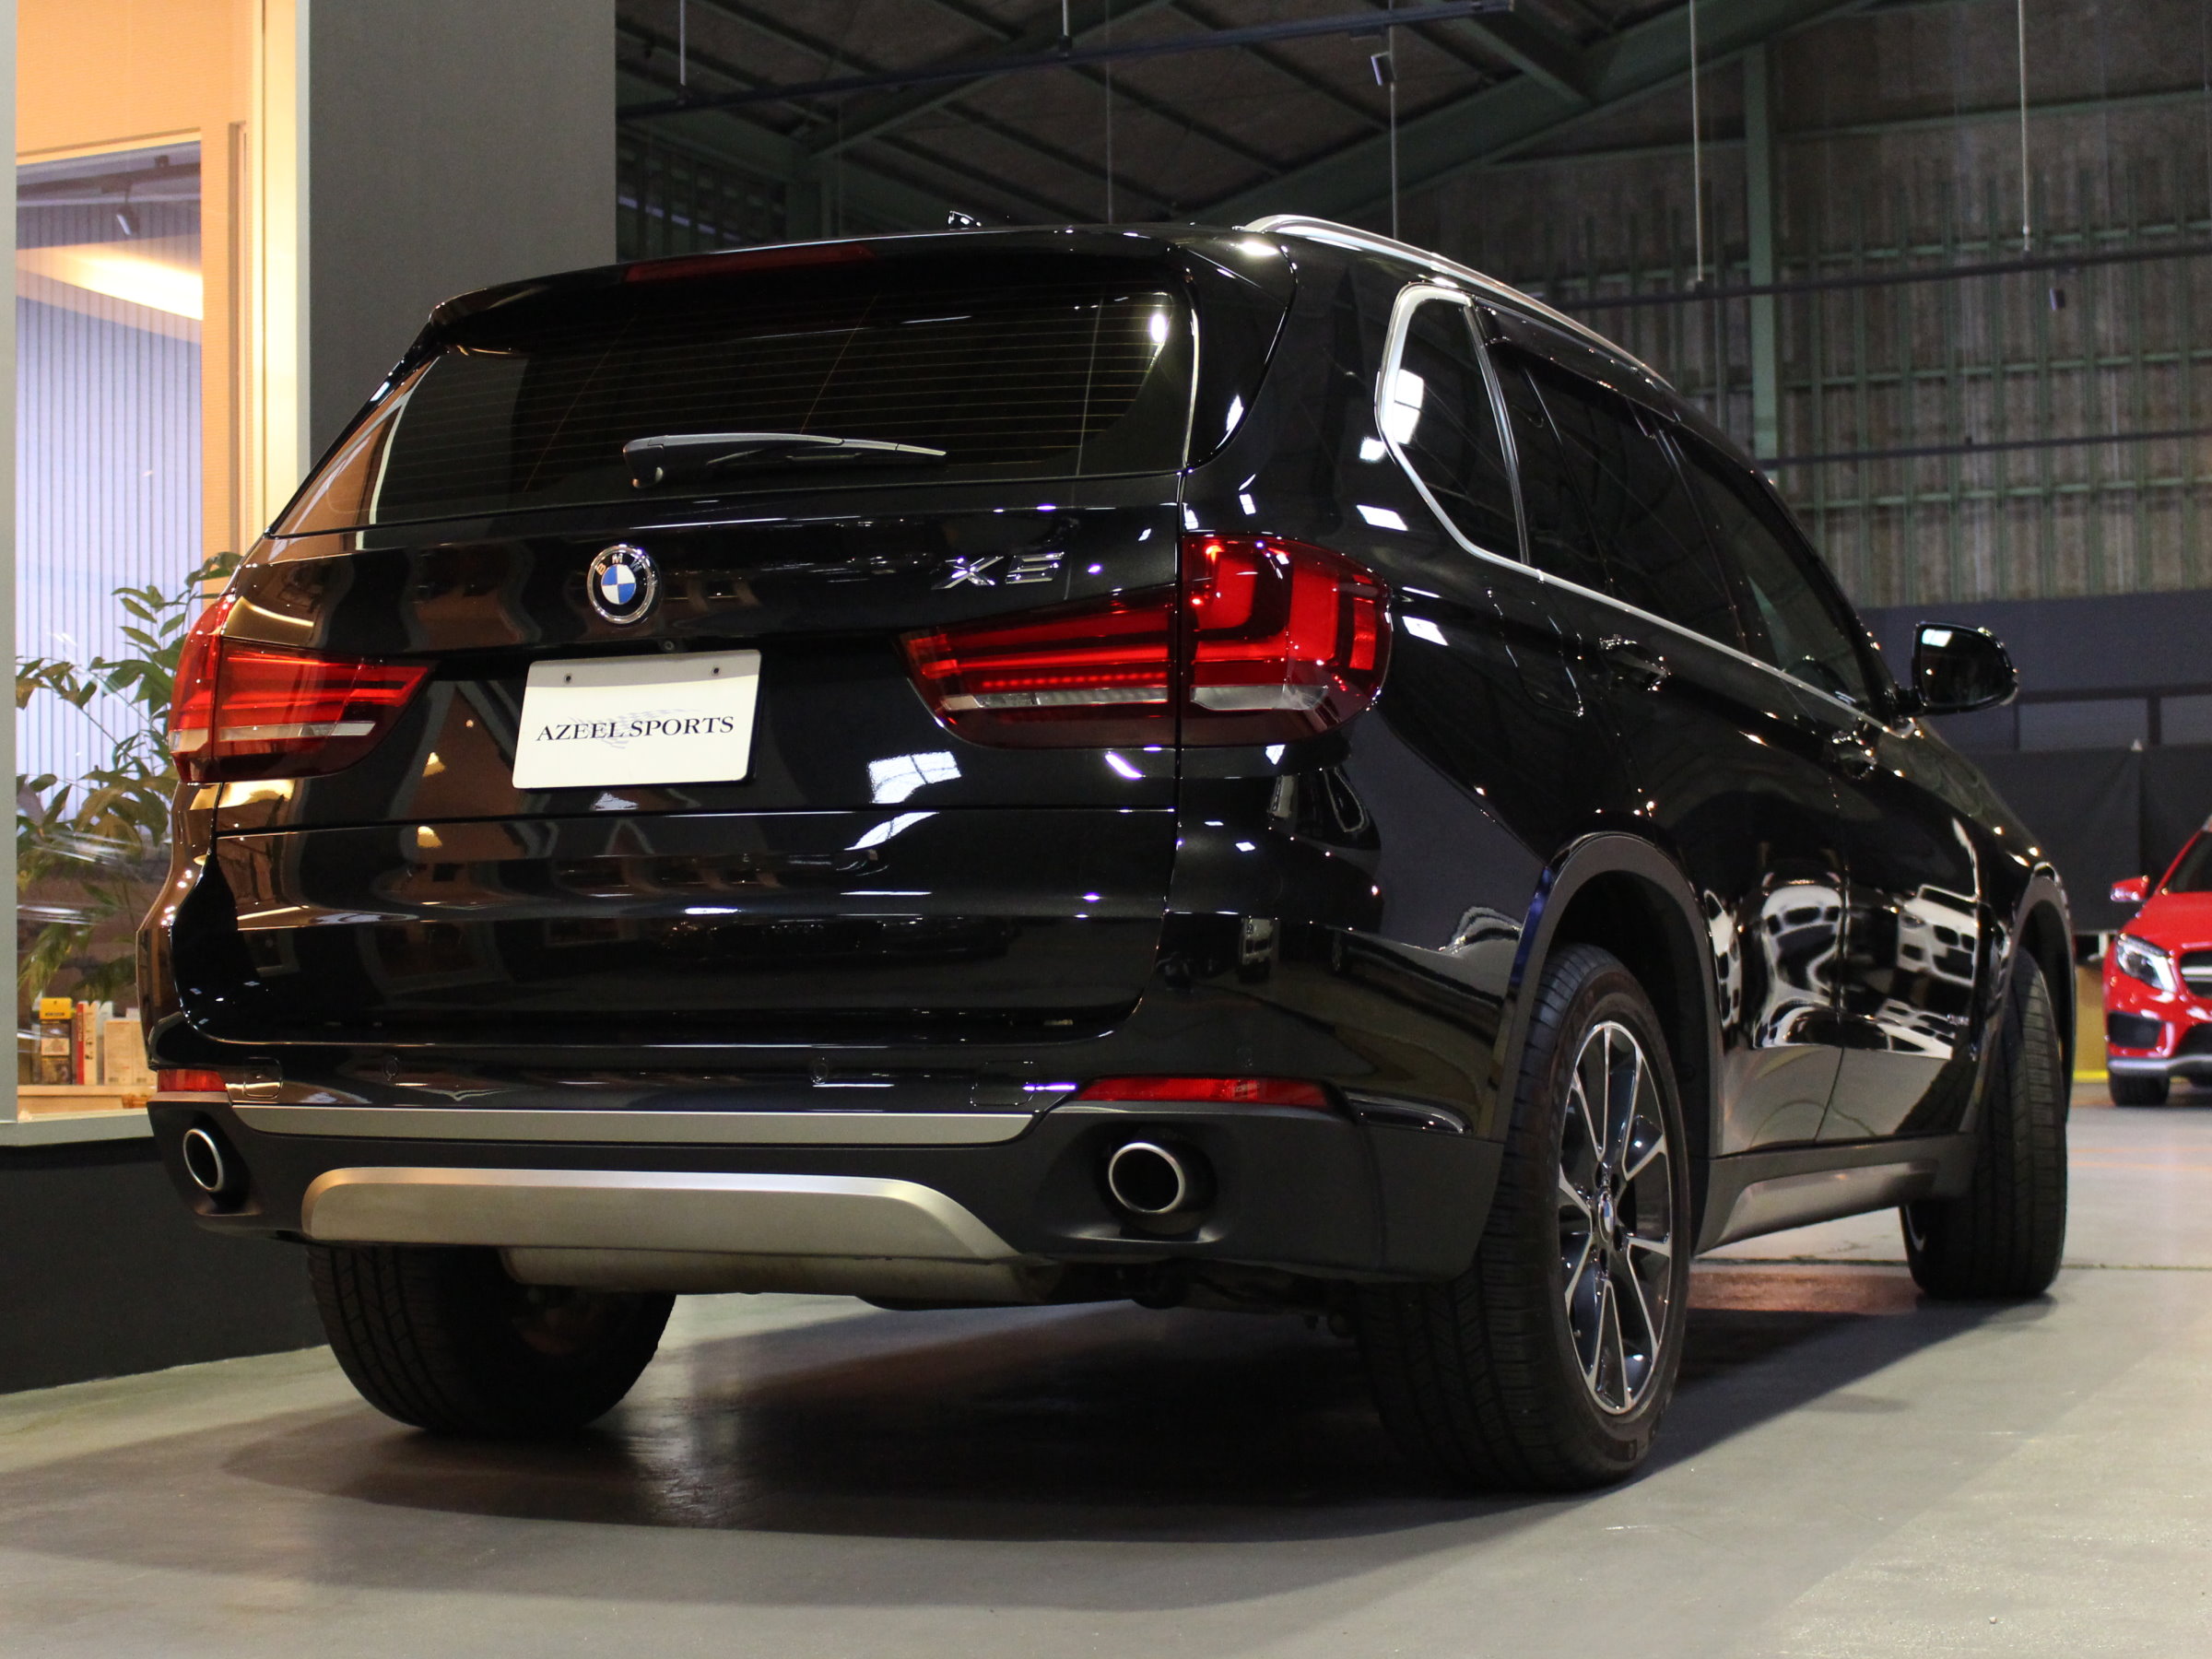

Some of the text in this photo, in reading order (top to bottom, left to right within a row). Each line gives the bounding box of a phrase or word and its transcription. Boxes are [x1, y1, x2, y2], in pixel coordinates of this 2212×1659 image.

[595, 553, 643, 576] BMW
[933, 551, 1065, 589] X5
[536, 715, 735, 741] AZEEL SPORTS
